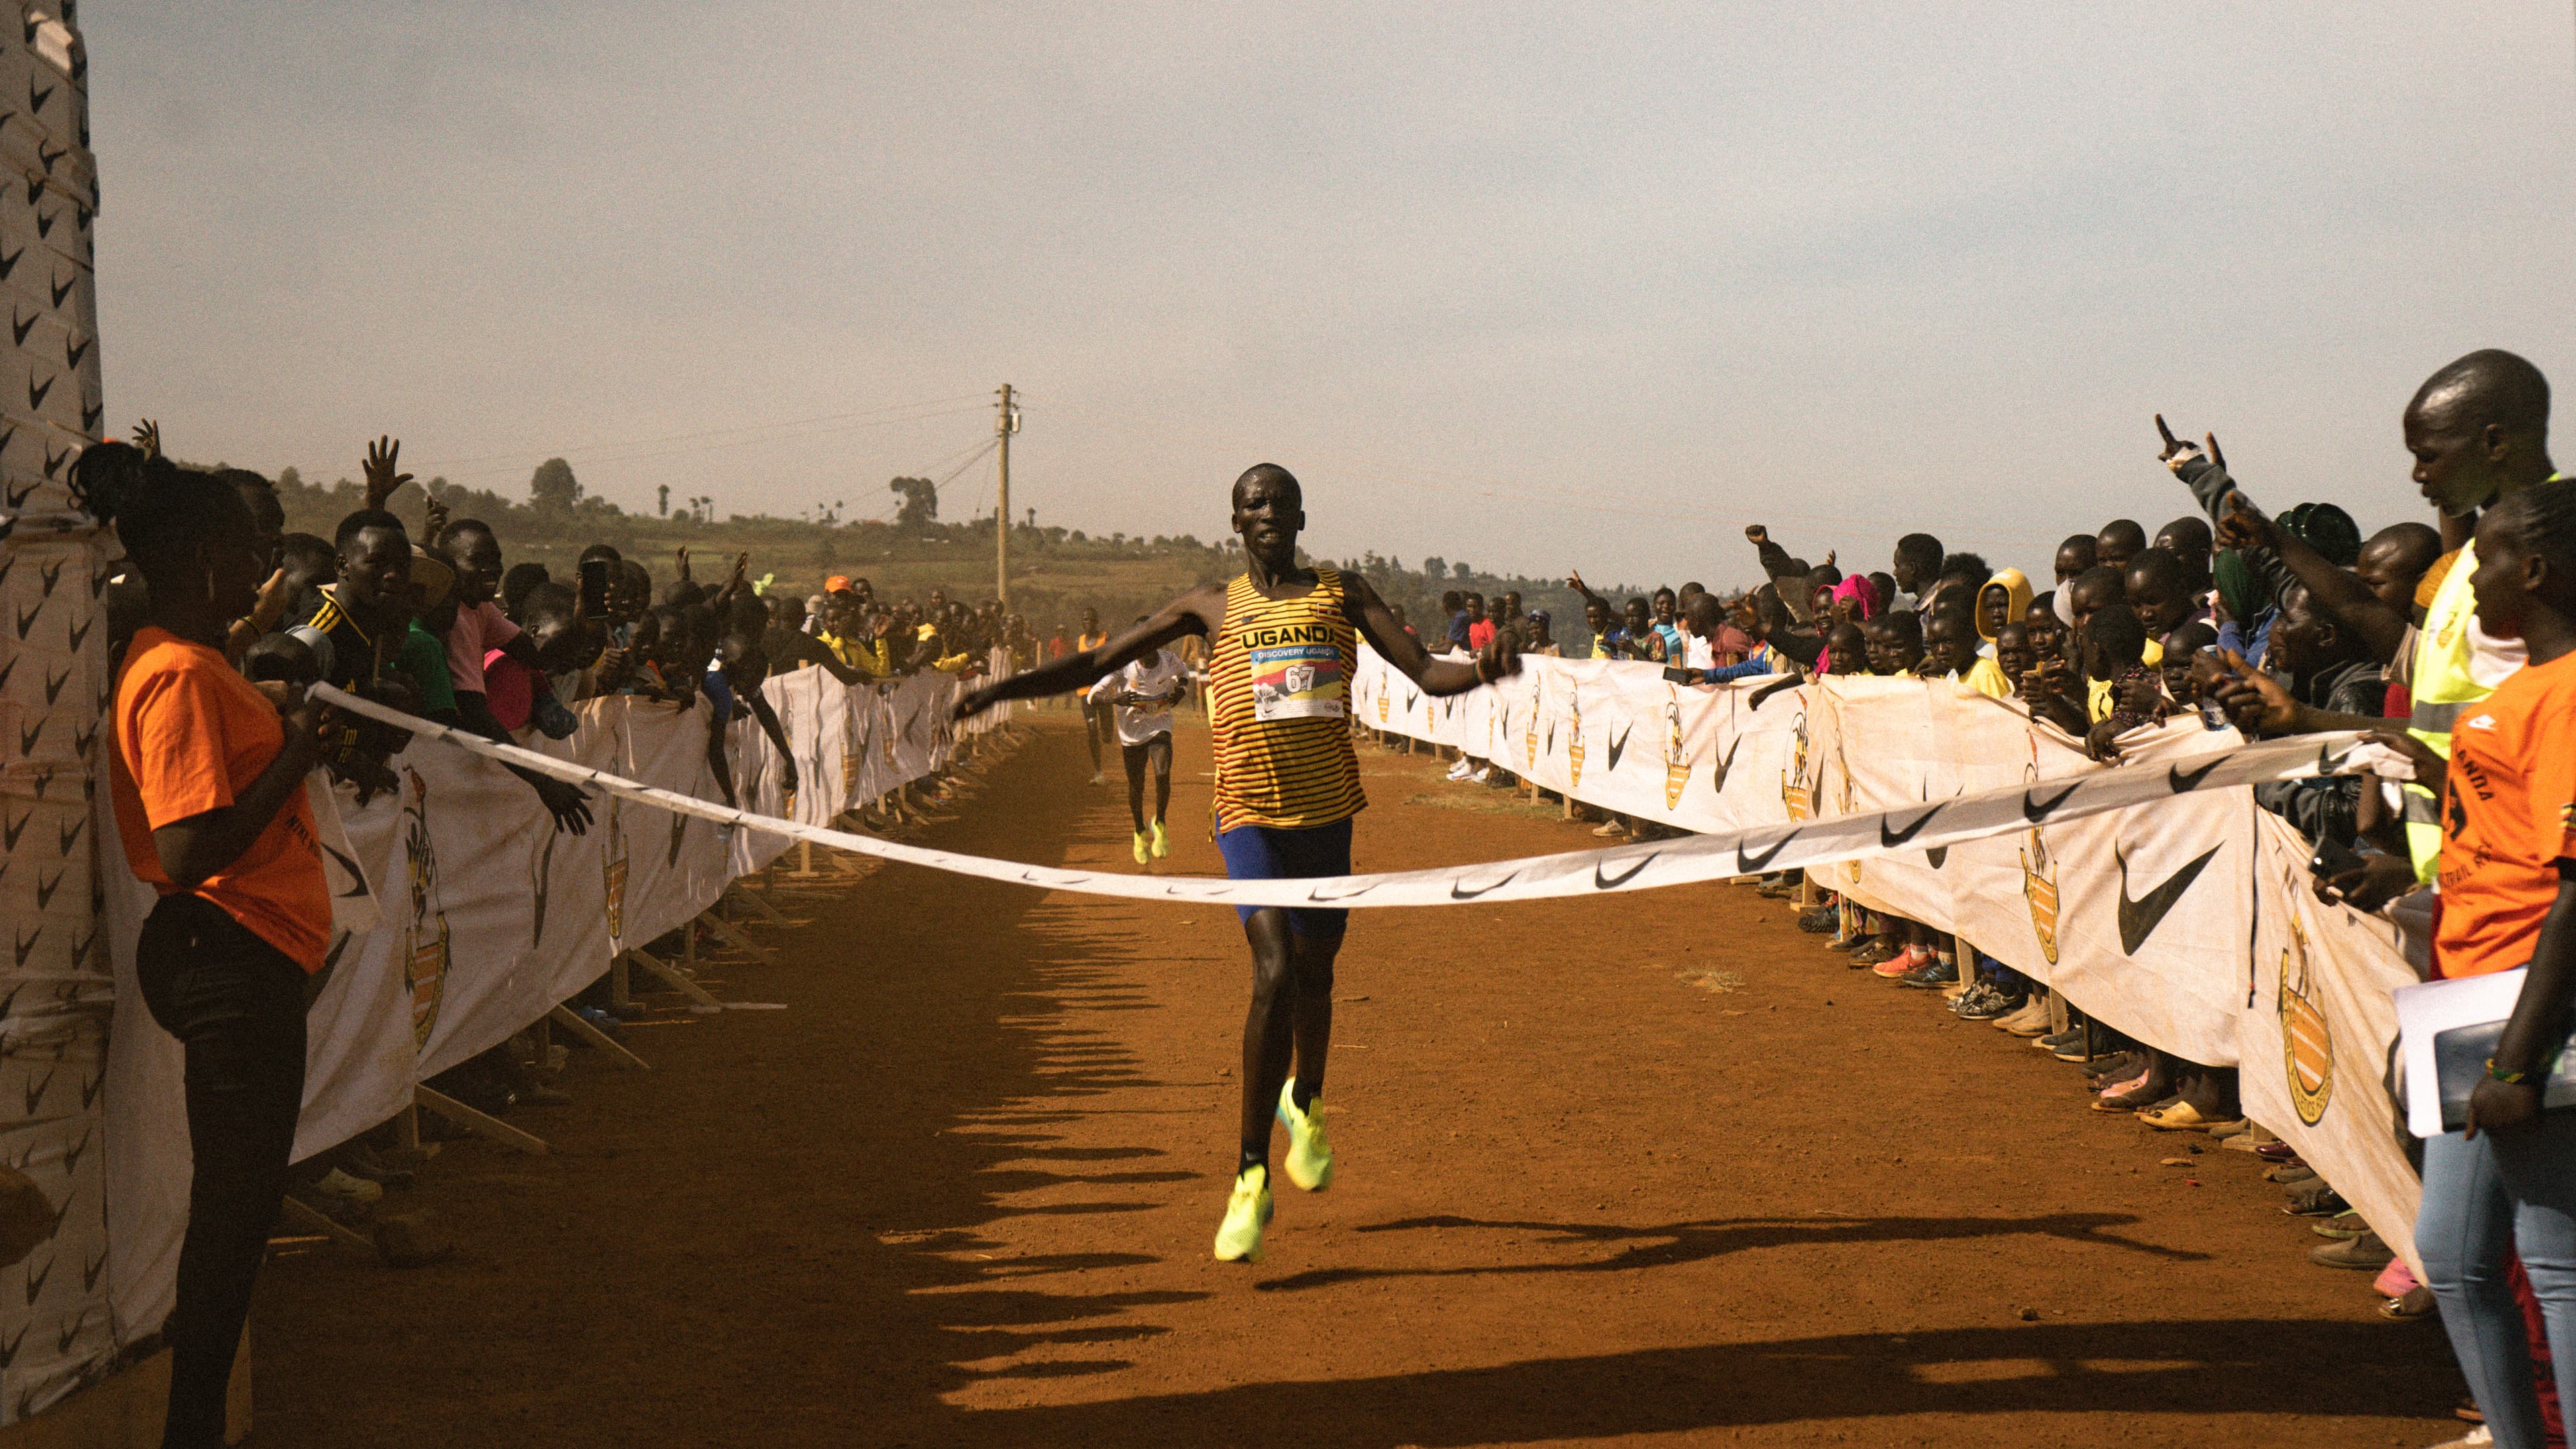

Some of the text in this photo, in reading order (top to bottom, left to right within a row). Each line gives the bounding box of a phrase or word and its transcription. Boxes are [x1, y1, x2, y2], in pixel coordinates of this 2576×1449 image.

[1258, 647, 1334, 659] DISCOVERY UGANDA
[1285, 665, 1316, 692] 67
